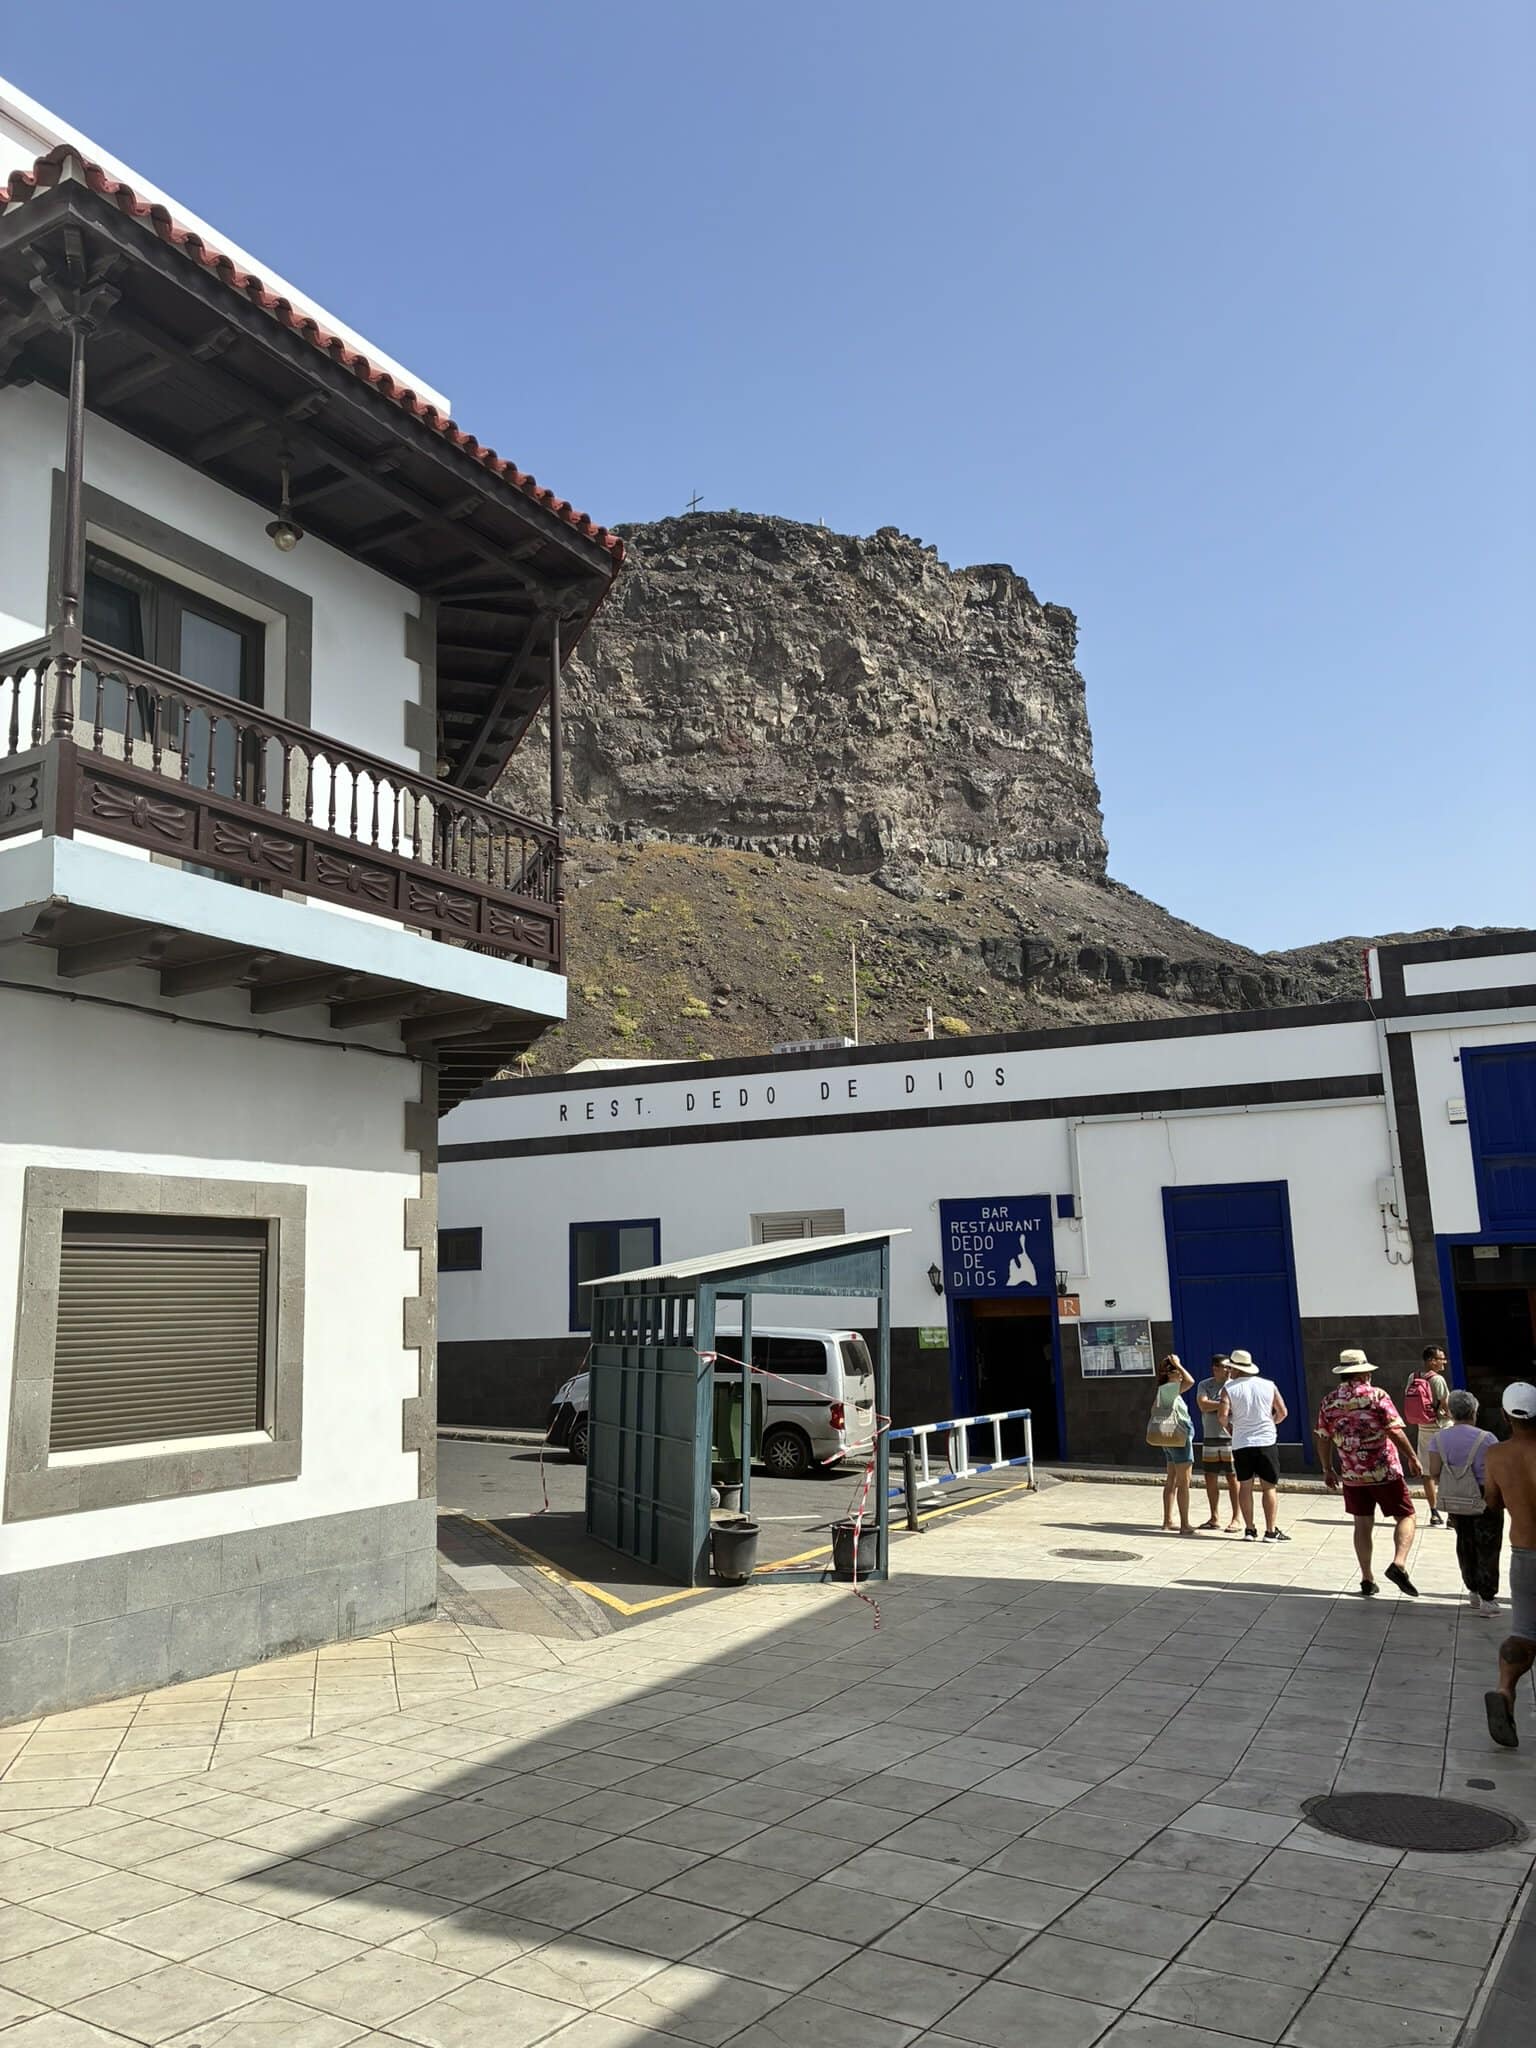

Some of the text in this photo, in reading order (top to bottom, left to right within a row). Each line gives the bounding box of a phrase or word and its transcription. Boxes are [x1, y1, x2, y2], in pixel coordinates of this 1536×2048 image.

[559, 1068, 1005, 1122] REST. DEDO DE DIOS
[982, 1206, 1009, 1219] BAR
[950, 1219, 1041, 1234] RESTAURANT
[951, 1235, 994, 1251] DEDO
[963, 1253, 985, 1269] DE
[953, 1270, 997, 1287] DIOS
[1063, 1299, 1077, 1315] R
